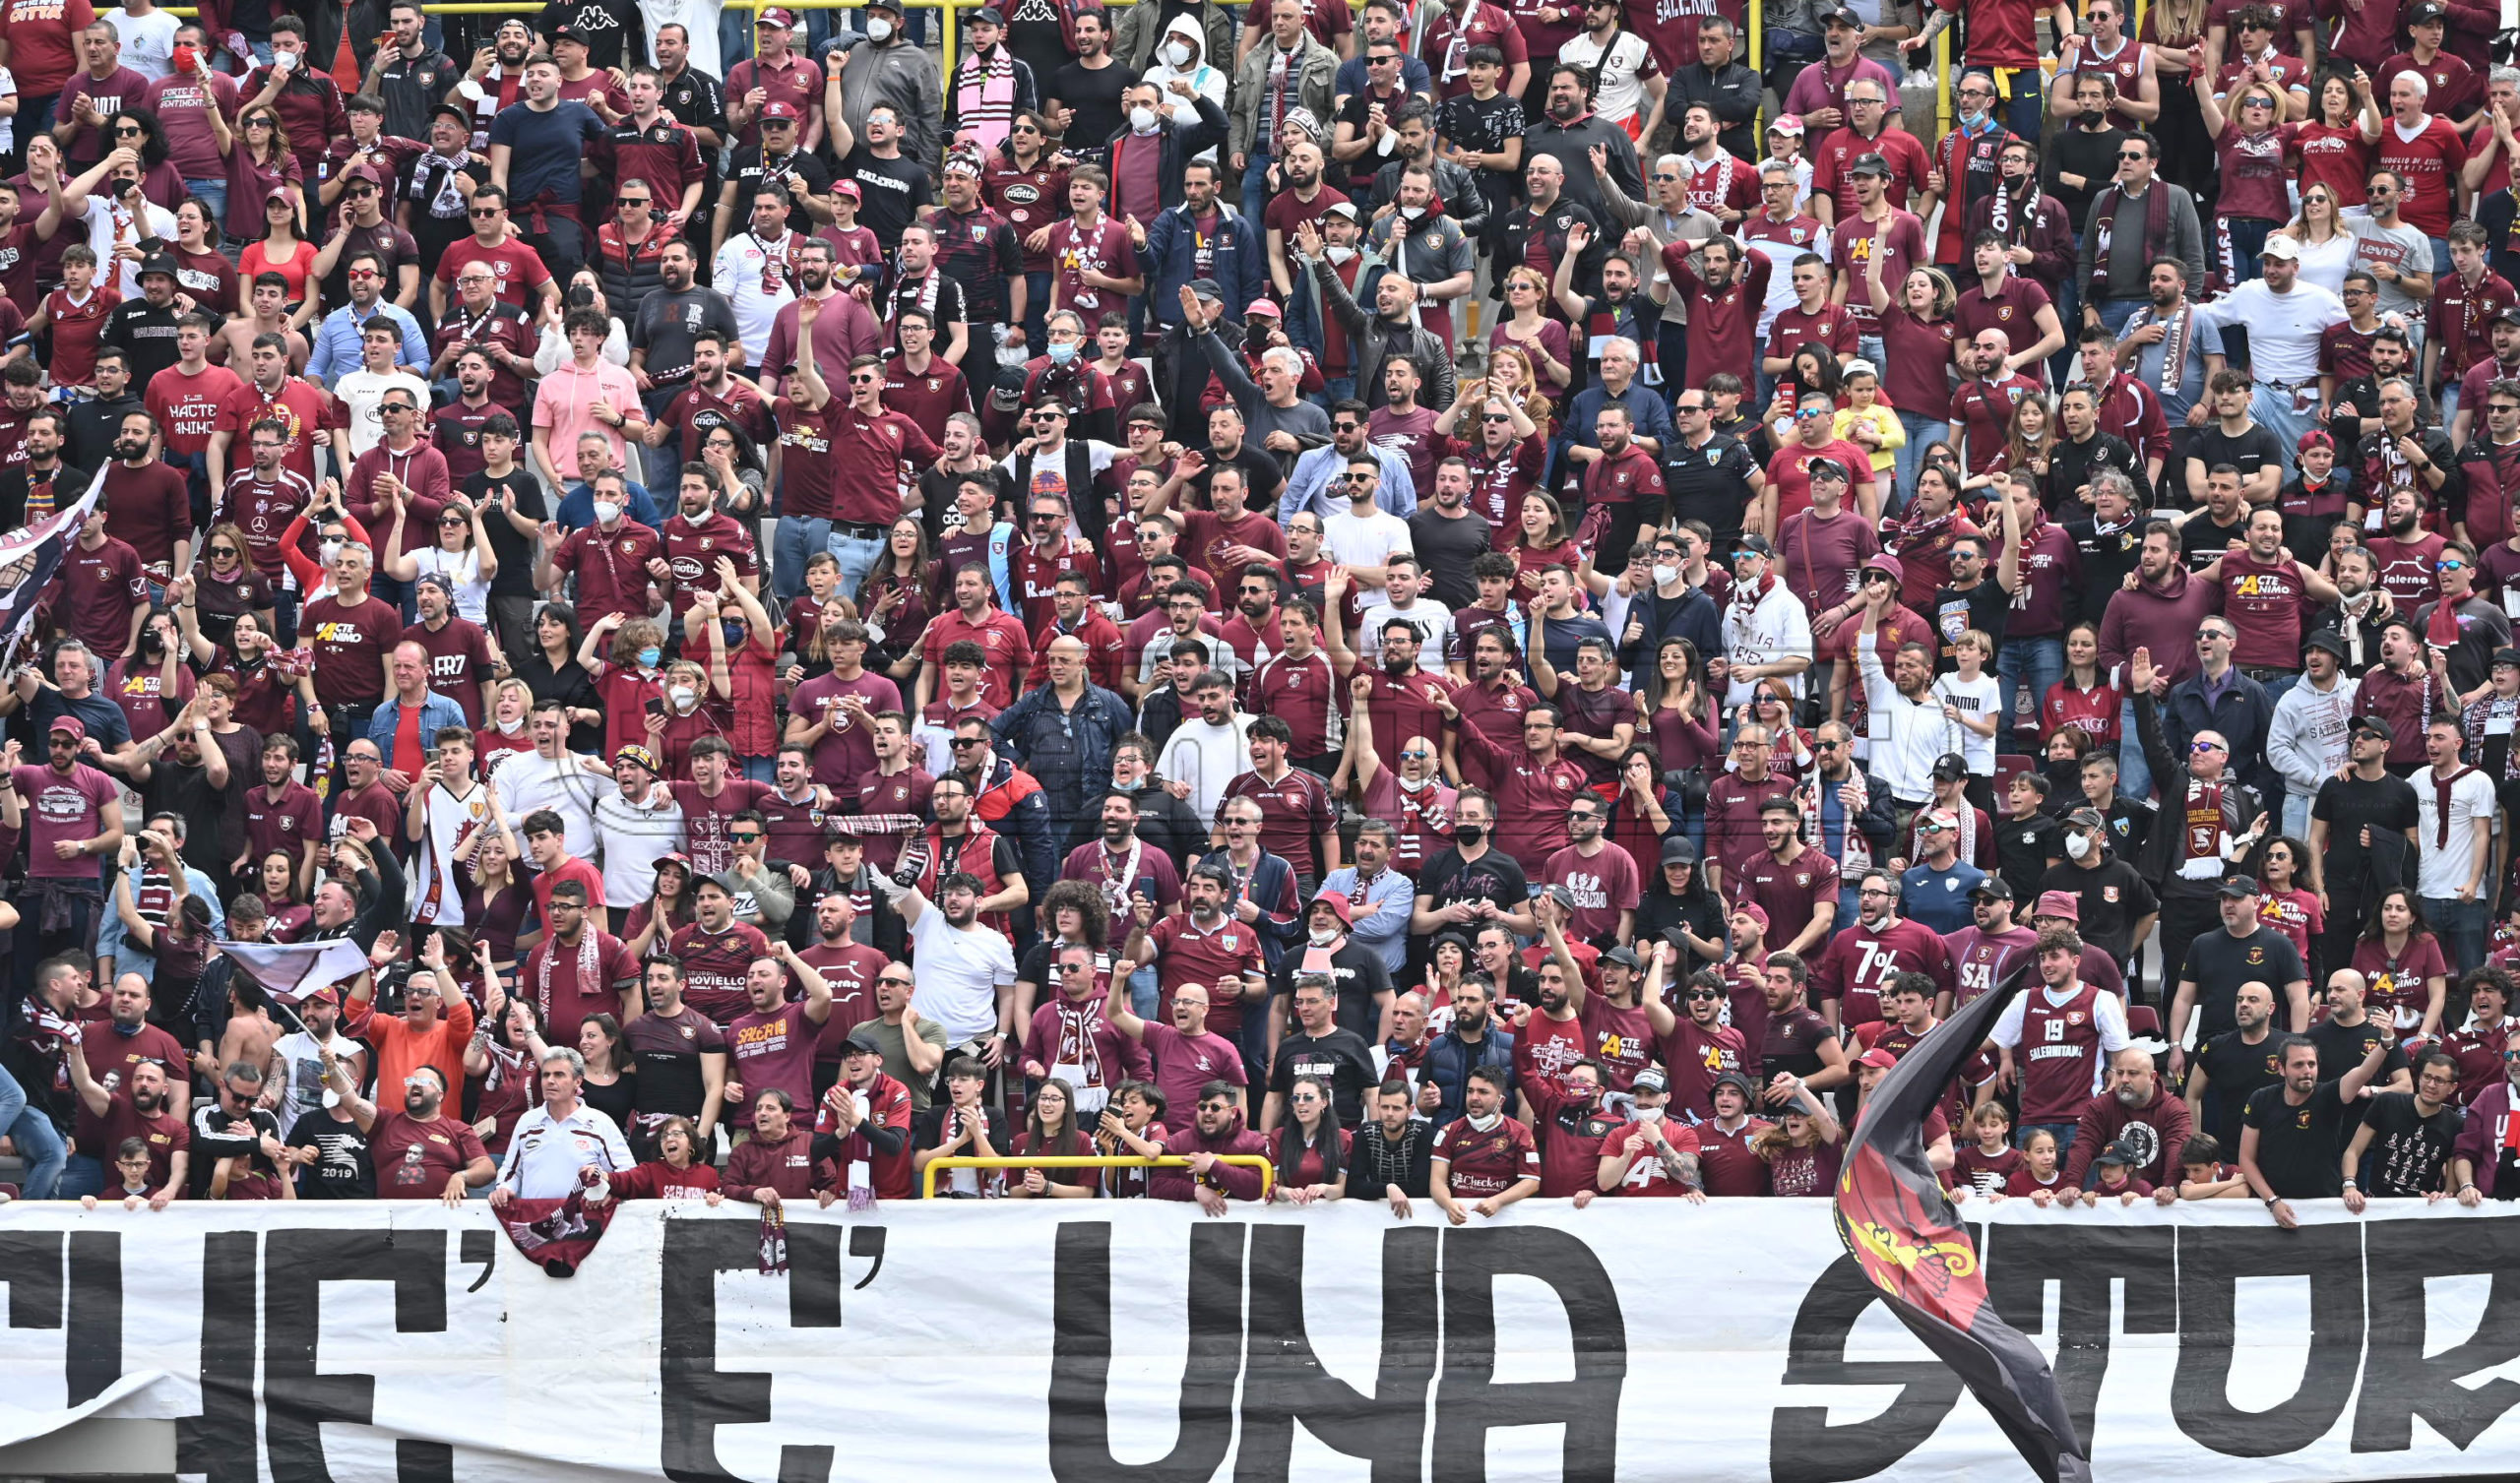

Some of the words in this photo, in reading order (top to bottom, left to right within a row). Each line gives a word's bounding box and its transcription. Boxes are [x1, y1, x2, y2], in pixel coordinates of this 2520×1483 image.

[1007, 189, 1039, 200] motta
[695, 415, 722, 426] mott
[672, 564, 702, 575] motta
[2382, 574, 2428, 585] Salerno
[434, 654, 466, 676] FR7
[1945, 694, 1981, 711] PUMA
[688, 976, 746, 987] NOVIELLO
[2045, 1019, 2065, 1041] 19
[2461, 1043, 2482, 1053] Zeus
[322, 1167, 353, 1178] 2019
[661, 1218, 885, 1483] E'
[1048, 1220, 1627, 1483] UNA
